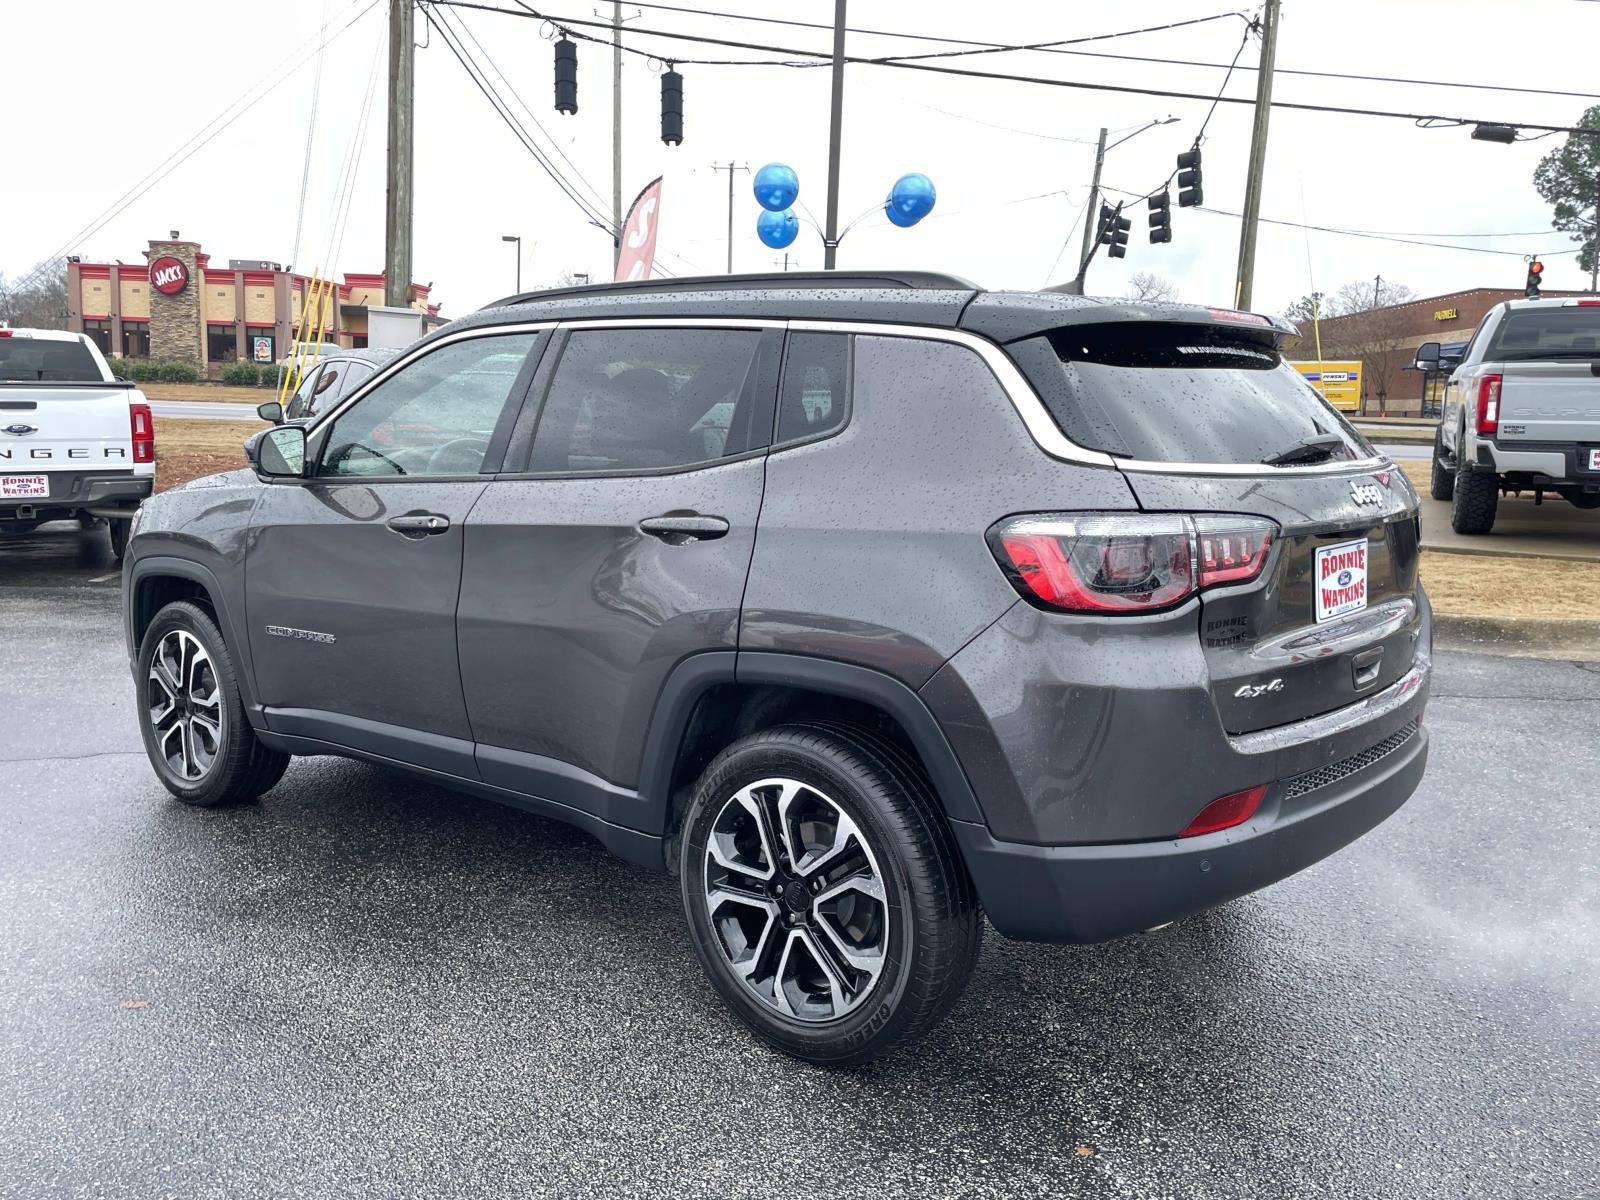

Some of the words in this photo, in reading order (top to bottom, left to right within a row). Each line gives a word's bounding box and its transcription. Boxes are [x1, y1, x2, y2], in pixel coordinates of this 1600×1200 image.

[3, 486, 45, 494] WATKINS
[1350, 480, 1383, 508] Jeep
[1321, 549, 1365, 580] RONNIE
[1322, 578, 1365, 609] WATKINS
[266, 625, 336, 643] COMPASS
[1207, 616, 1248, 632] RONNIE
